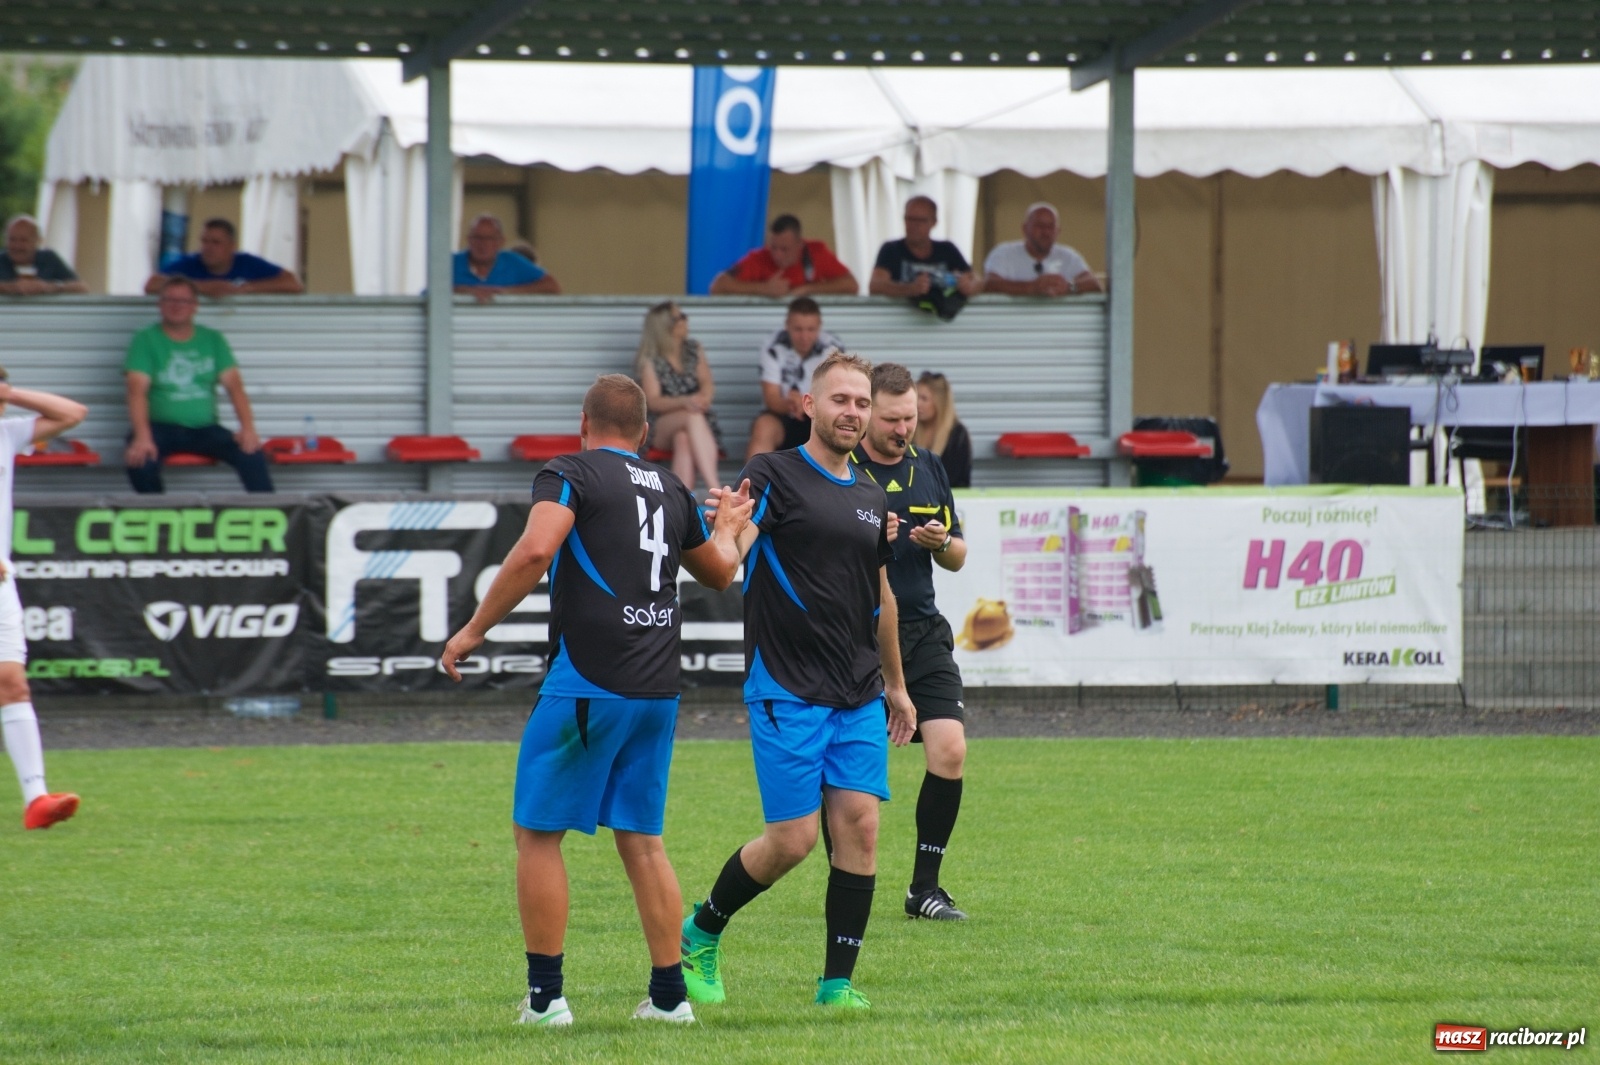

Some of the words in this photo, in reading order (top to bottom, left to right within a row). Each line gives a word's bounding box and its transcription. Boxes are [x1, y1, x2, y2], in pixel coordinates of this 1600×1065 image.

[1262, 506, 1312, 528] Poczuj
[11, 510, 55, 554] L
[75, 509, 288, 552] CENTER
[635, 495, 669, 592] 4
[14, 560, 127, 579] TOWNIA
[1243, 539, 1364, 590] H40
[1299, 584, 1327, 609] BEZ
[23, 606, 73, 641] ea
[623, 602, 674, 627] safer
[1190, 622, 1243, 638] Pierwszy
[1246, 622, 1269, 638] Klej
[1320, 621, 1352, 638] który
[1342, 648, 1444, 667] KERAKOLL
